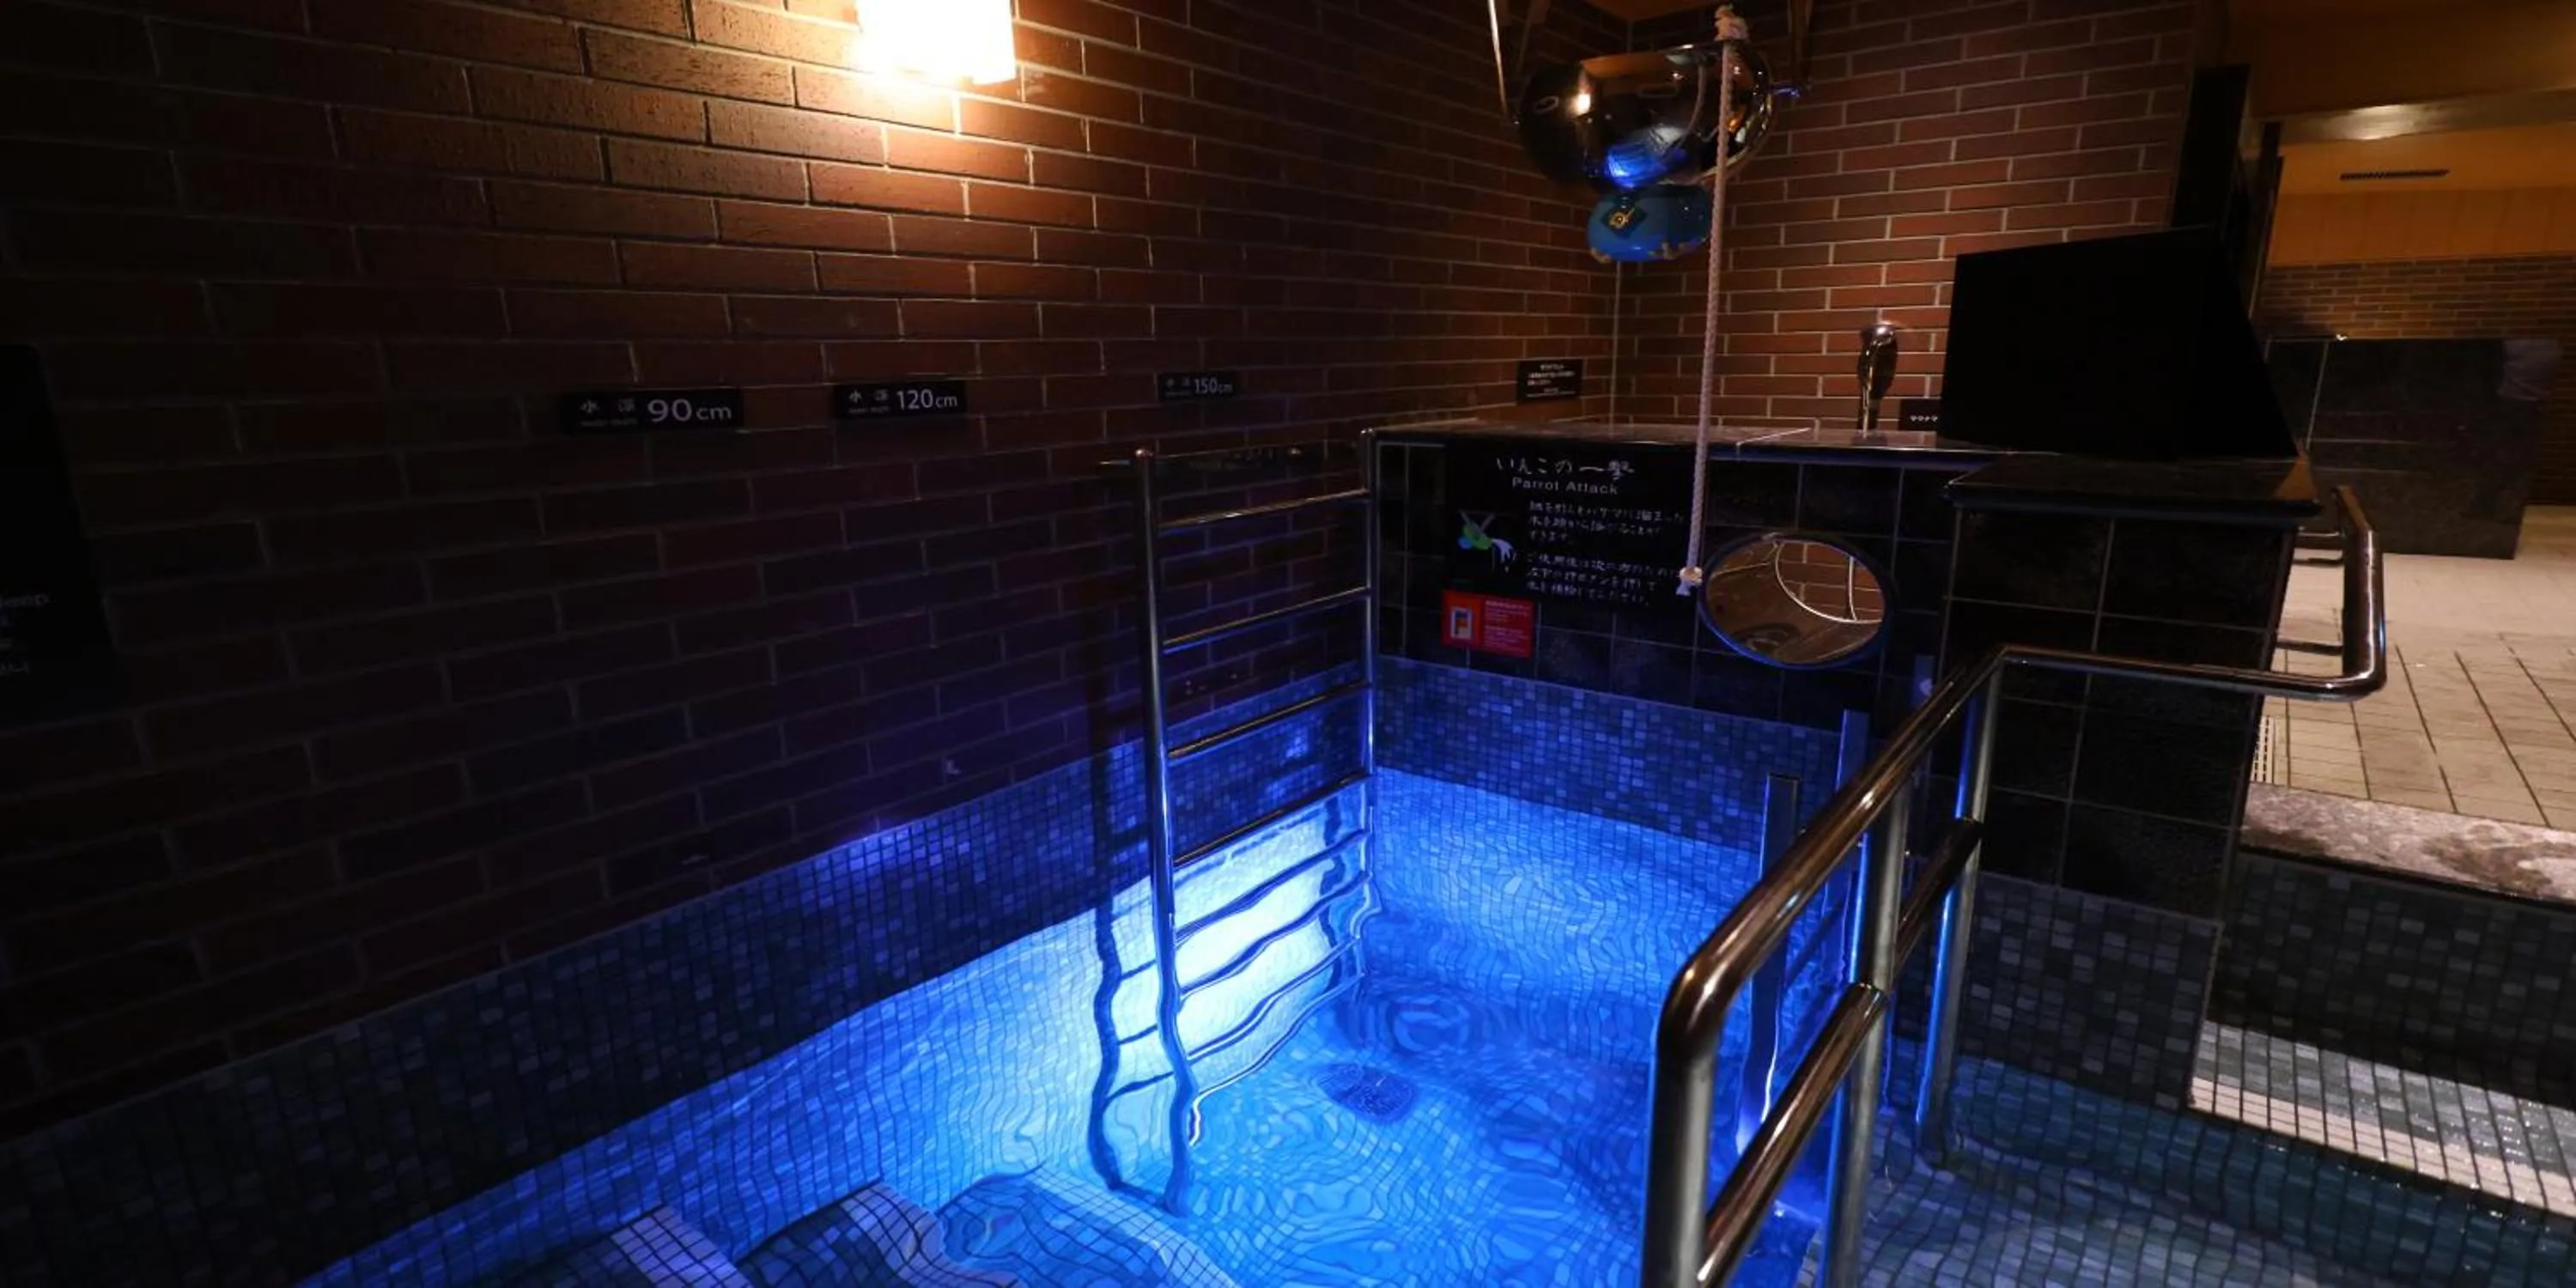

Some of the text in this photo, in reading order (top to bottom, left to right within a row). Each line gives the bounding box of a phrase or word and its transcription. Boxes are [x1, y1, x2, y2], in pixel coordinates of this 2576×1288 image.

[646, 398, 732, 422] 90cm
[896, 388, 959, 410] 120cm
[1511, 476, 1620, 495] Parrot Attack
